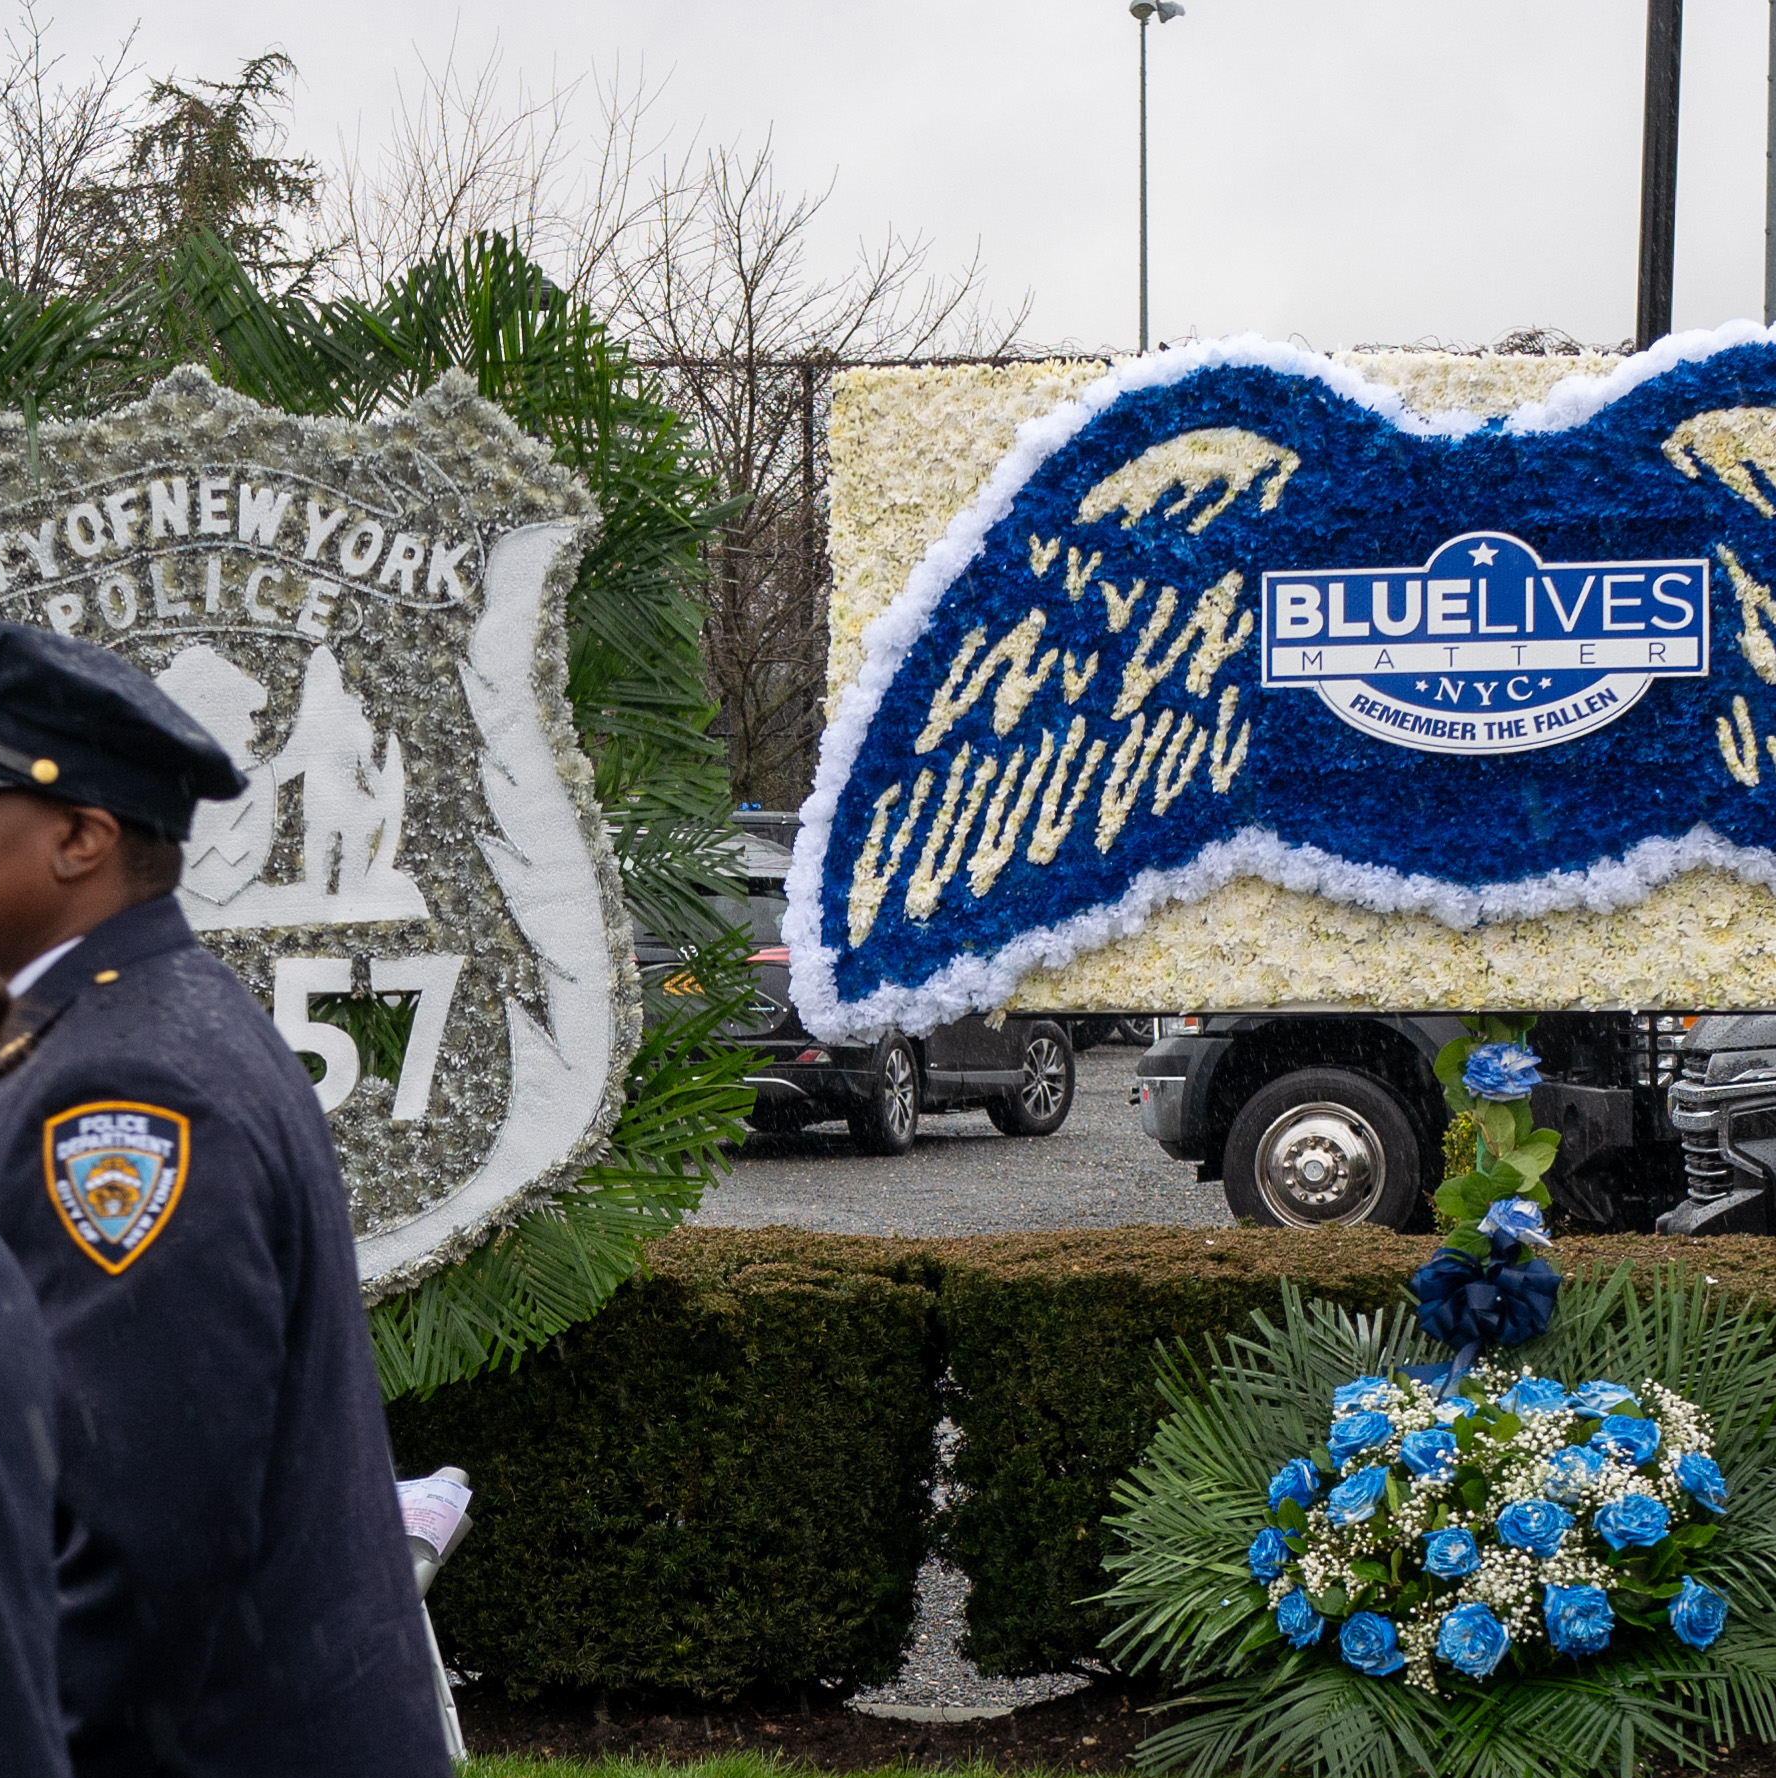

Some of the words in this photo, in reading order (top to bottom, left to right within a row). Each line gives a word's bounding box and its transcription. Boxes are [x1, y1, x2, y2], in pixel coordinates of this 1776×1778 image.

[66, 487, 141, 558] OF
[150, 477, 293, 546] NEW
[302, 499, 474, 601] YORK
[46, 557, 341, 639] POLICE
[1300, 641, 1667, 672] MATTER
[1434, 676, 1533, 706] NYC
[1349, 693, 1476, 741] REMEMBER
[1483, 718, 1528, 741] THE
[1532, 687, 1619, 734] FALLEN
[79, 1114, 150, 1134] POLICE
